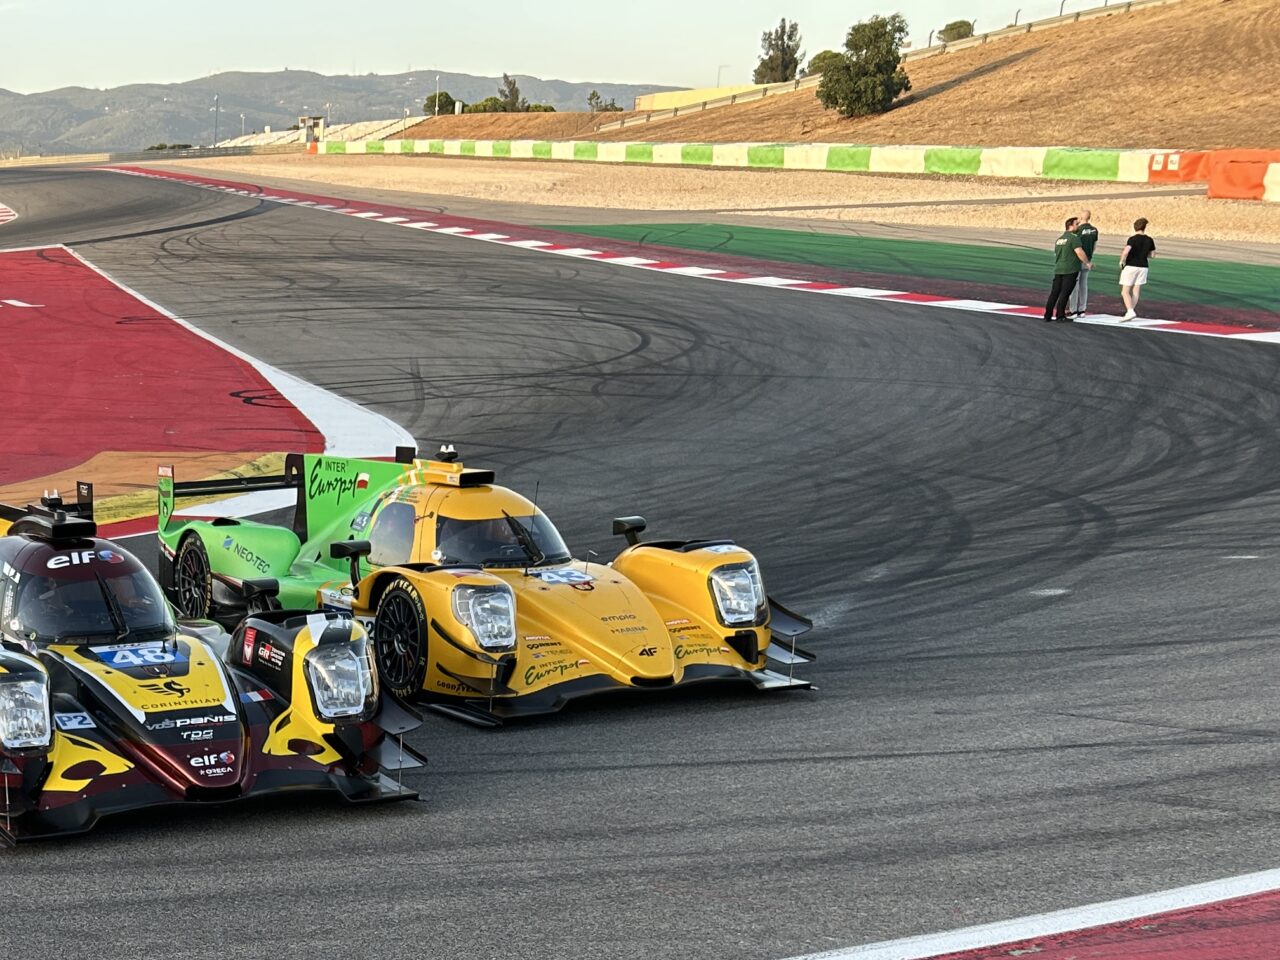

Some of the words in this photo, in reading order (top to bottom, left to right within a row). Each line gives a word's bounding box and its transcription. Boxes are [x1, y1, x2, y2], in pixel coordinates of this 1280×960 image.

[325, 461, 346, 473] INTER
[309, 458, 358, 505] Europol
[47, 550, 95, 569] elf
[233, 544, 271, 574] NEO-TEC
[540, 569, 594, 584] 43
[112, 648, 176, 665] 48
[258, 647, 270, 660] GR
[525, 660, 579, 686] Europol
[141, 697, 221, 710] CORINTHIAN
[56, 714, 93, 727] P2
[190, 753, 219, 768] elf
